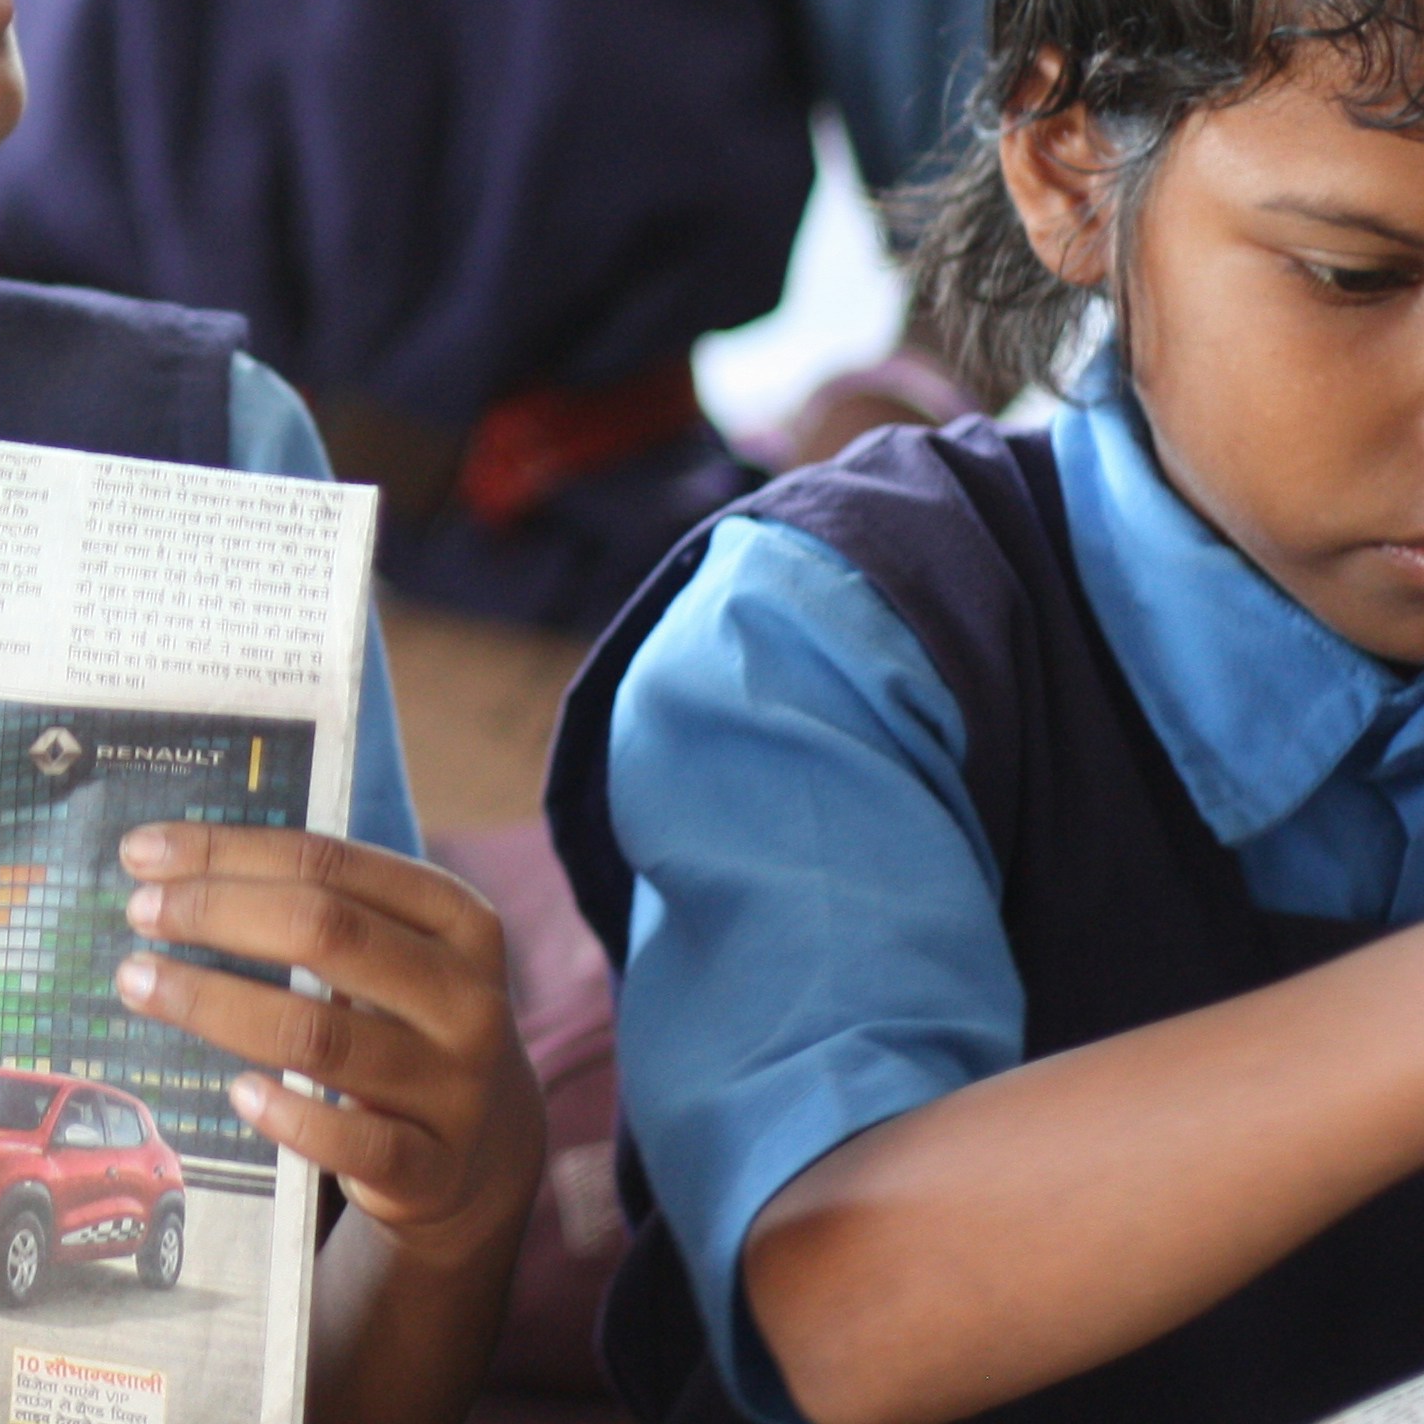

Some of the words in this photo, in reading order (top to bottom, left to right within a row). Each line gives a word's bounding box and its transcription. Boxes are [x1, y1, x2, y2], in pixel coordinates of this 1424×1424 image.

[95, 741, 225, 767] RENAULT
[17, 1355, 39, 1374] 10
[17, 1374, 57, 1393] विजेता
[105, 1390, 130, 1404] VIP
[15, 1392, 53, 1409] लाउंज
[59, 1398, 70, 1412] से
